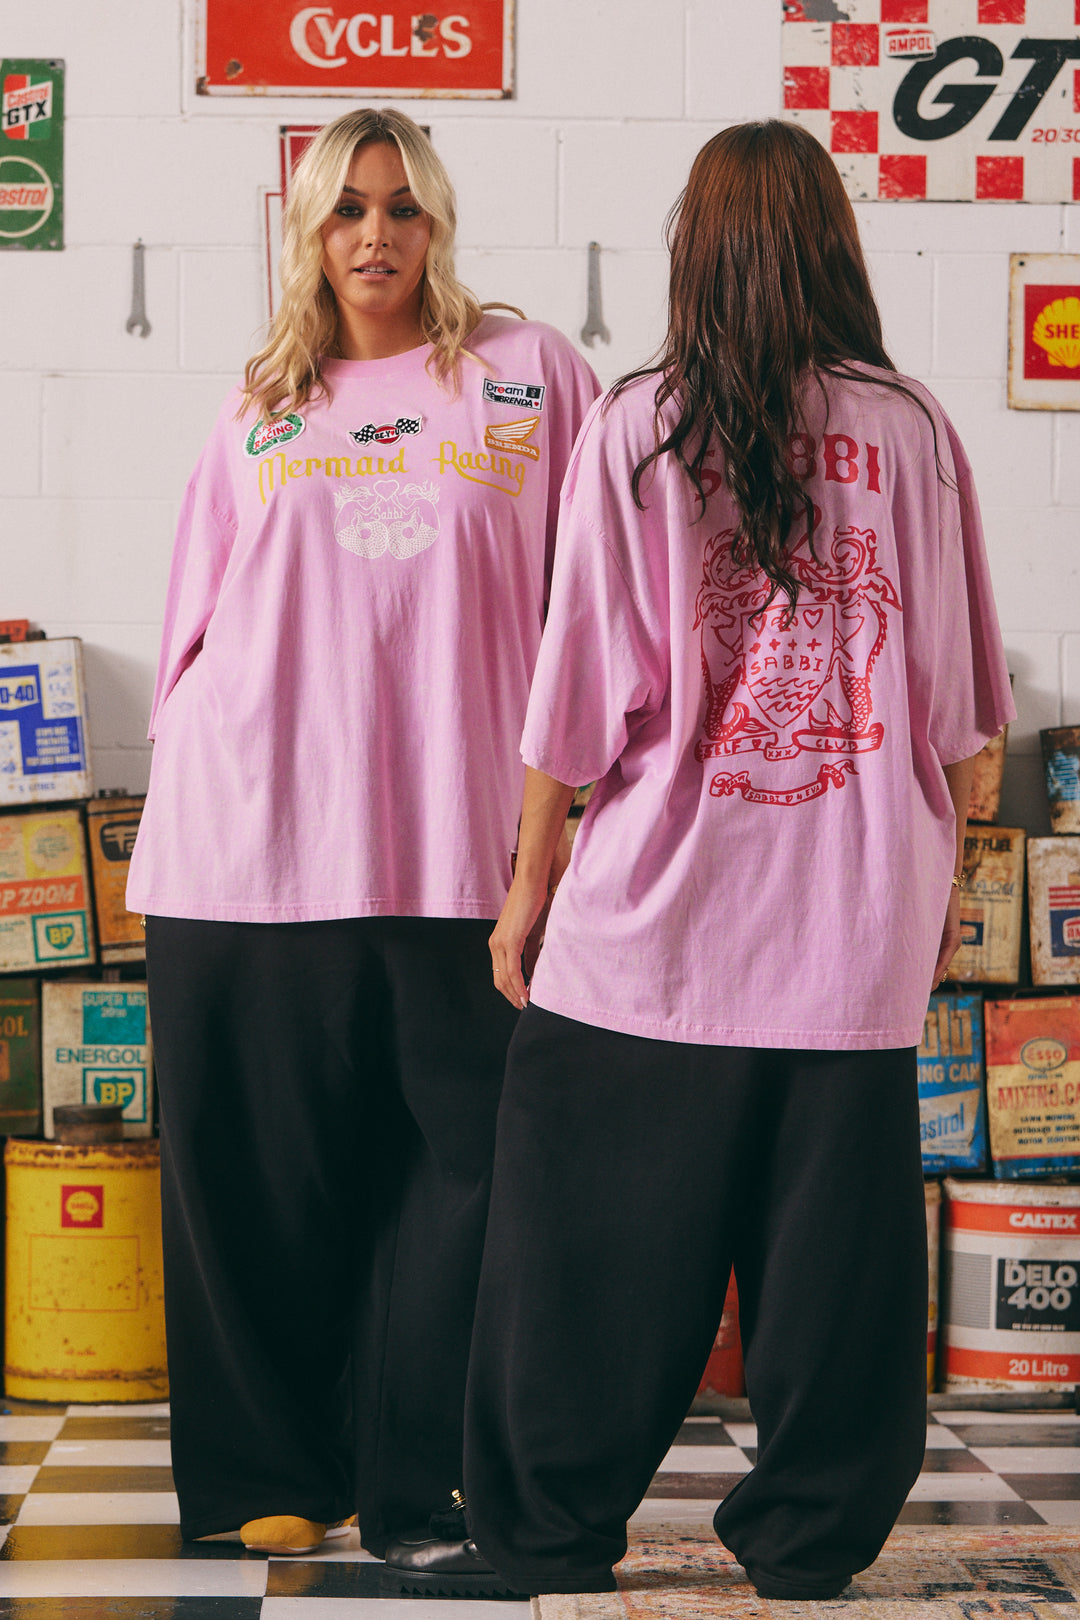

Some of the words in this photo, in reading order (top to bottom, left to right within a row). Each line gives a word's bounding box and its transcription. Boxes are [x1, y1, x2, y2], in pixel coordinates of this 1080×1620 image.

[289, 7, 473, 69] CYCLES
[888, 37, 933, 54] AMPOL
[892, 35, 1080, 141] GT
[8, 100, 47, 126] GTX
[254, 423, 294, 451] RACING
[487, 438, 538, 457] BRENDA
[258, 446, 410, 505] Mermaid
[431, 440, 526, 498] Racing
[694, 433, 881, 502] SBBI
[750, 654, 824, 676] SABBI
[747, 790, 780, 803] SABBI
[982, 837, 1013, 852] FUEL
[18, 882, 78, 908] ZOOM
[49, 926, 73, 945] BP
[83, 992, 124, 1007] SUPER
[55, 1047, 147, 1065] ENERGOL
[949, 1062, 981, 1083] CAN
[100, 1082, 134, 1105] BP
[998, 1083, 1059, 1110] MIXING
[1009, 1212, 1078, 1229] CALTEX
[1004, 1264, 1078, 1288] DELO
[1007, 1286, 1072, 1311] 400
[1009, 1358, 1030, 1376] 20
[1032, 1359, 1069, 1377] Litre
